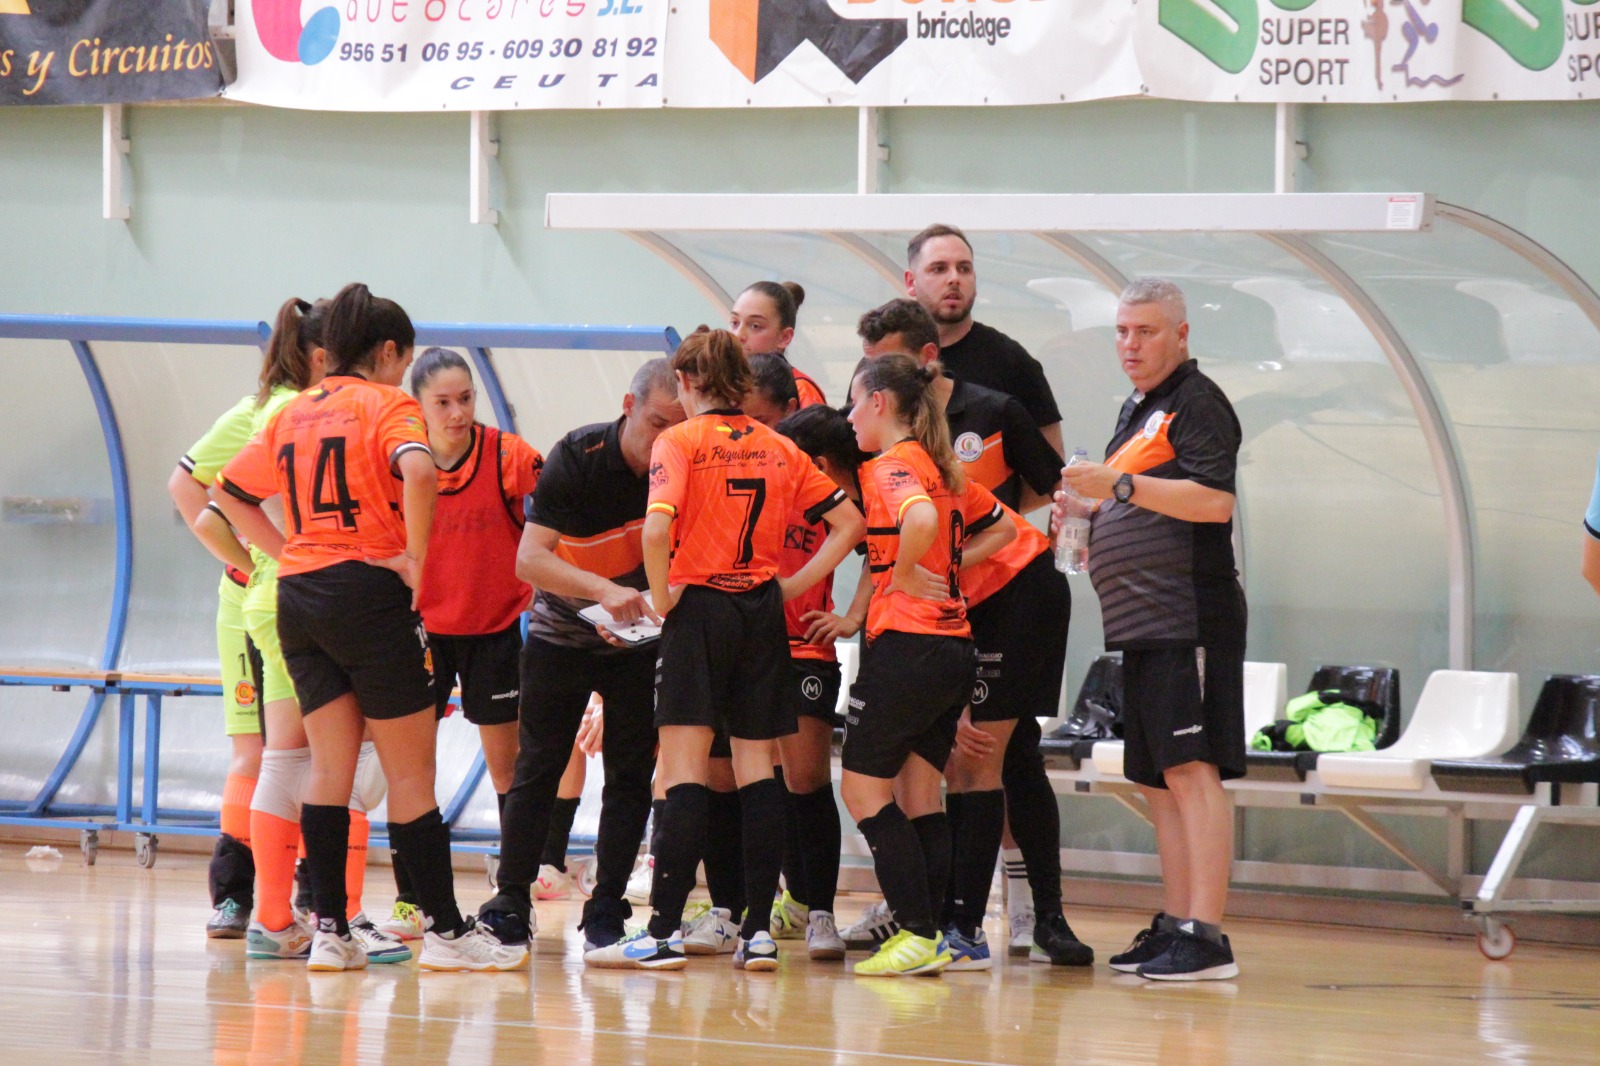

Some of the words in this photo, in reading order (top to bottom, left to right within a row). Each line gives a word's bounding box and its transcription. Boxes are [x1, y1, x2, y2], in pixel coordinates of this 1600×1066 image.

[917, 11, 1011, 46] bricolage
[1260, 17, 1350, 46] SUPER
[22, 50, 55, 96] y
[68, 33, 214, 77] Circuitos
[339, 42, 375, 62] 956
[380, 43, 408, 63] 51
[421, 42, 451, 62] 06
[456, 41, 484, 61] 95
[502, 38, 544, 59] 609
[549, 38, 583, 58] 30
[592, 37, 618, 58] 81
[625, 37, 657, 57] 92
[450, 73, 658, 90] CEUTA
[1258, 58, 1350, 86] SPORT
[692, 448, 707, 465] La
[275, 435, 362, 535] 14
[725, 477, 766, 570] 7
